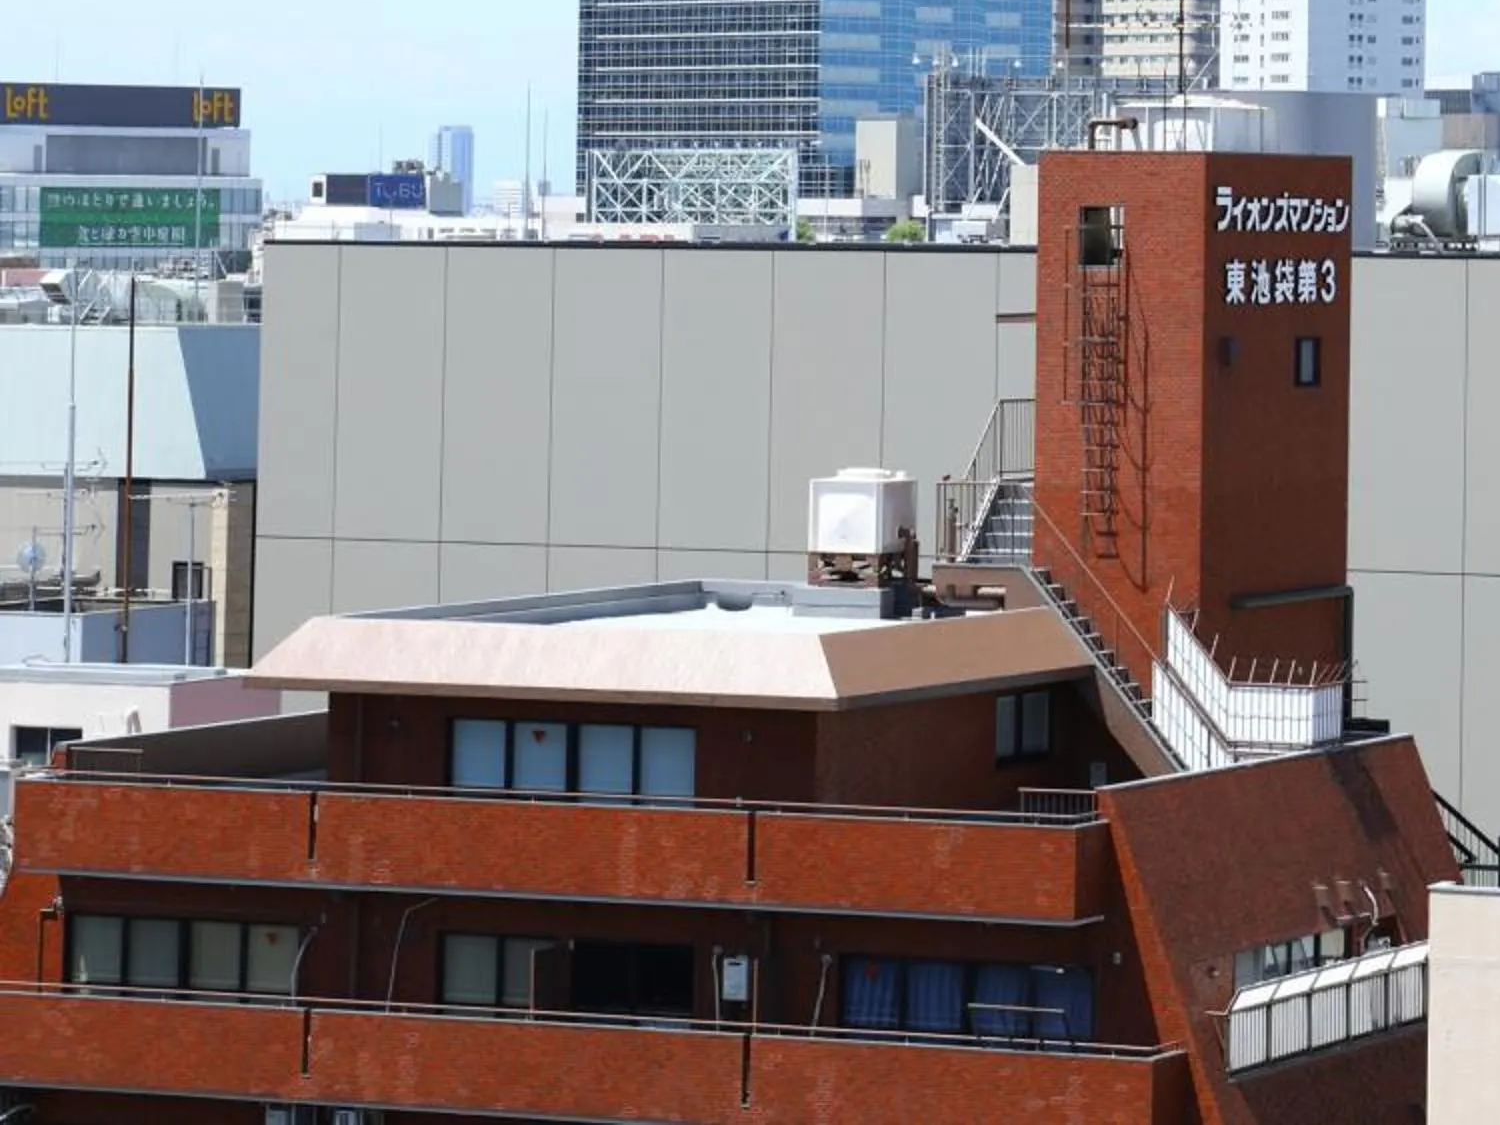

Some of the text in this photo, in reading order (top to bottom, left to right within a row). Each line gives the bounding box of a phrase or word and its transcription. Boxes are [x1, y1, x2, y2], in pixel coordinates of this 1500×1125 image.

[1216, 186, 1349, 231] ライオンズマンション
[1225, 259, 1336, 304] 東池袋第3
